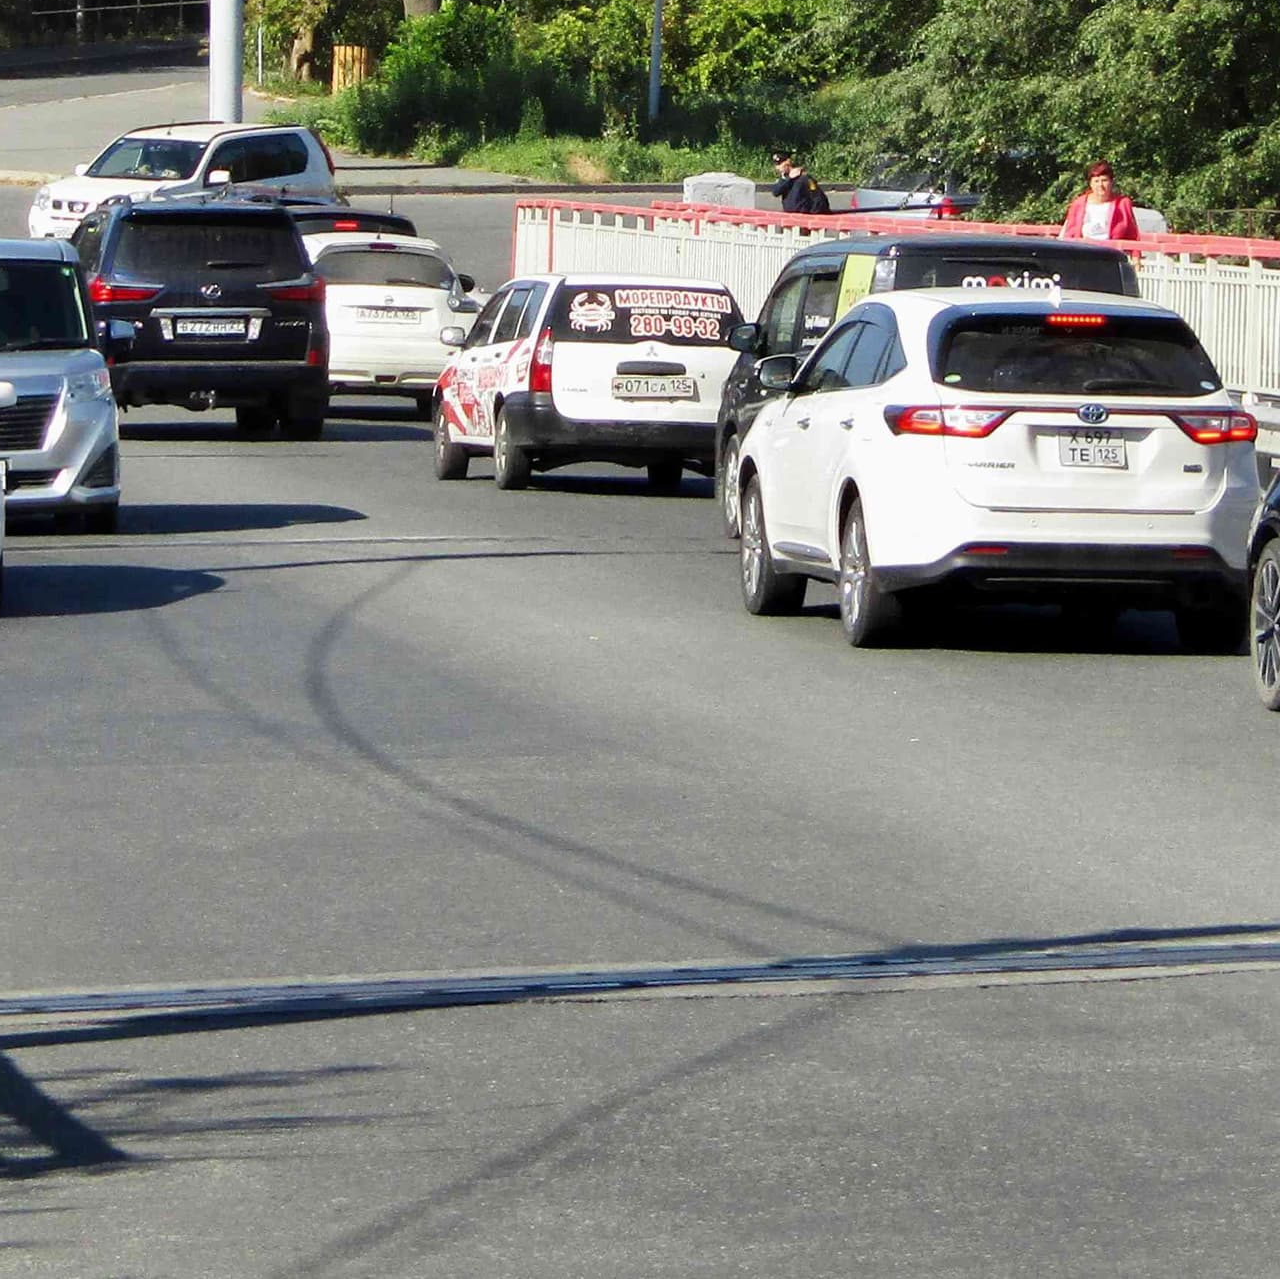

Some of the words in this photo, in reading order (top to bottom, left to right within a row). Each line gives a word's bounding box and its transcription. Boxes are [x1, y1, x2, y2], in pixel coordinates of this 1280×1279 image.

[616, 291, 730, 313] МОРЕПРОДУКТЫ
[631, 316, 719, 338] 280-99-32
[1085, 430, 1112, 445] 697
[1097, 448, 1118, 460] 125
